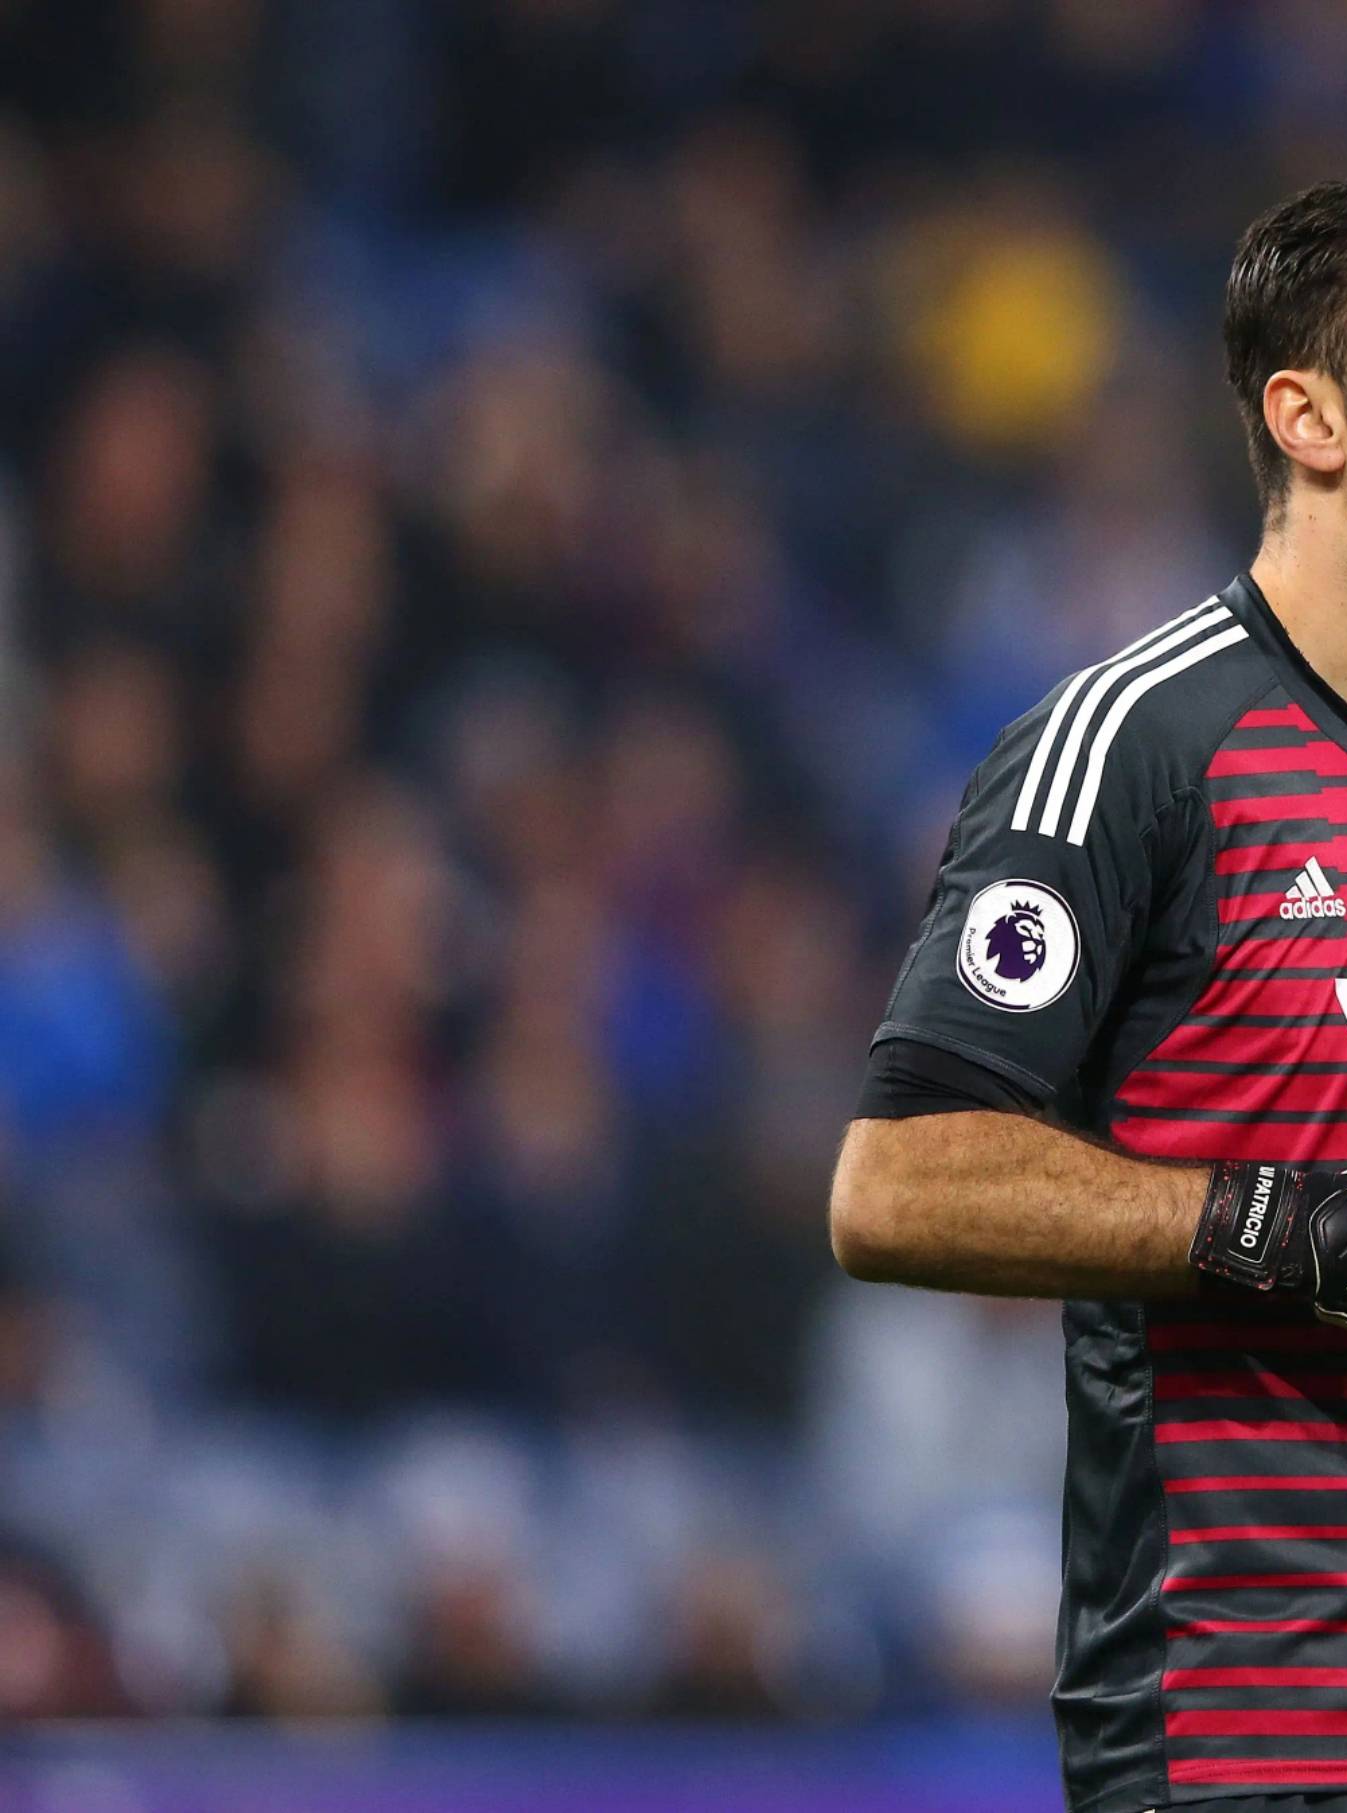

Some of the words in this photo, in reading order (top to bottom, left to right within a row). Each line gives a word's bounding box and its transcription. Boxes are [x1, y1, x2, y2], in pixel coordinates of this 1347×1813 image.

[1280, 898, 1346, 919] adidas
[965, 926, 977, 966] Premier
[972, 967, 1006, 997] League
[1240, 1177, 1274, 1248] PATRICIO
